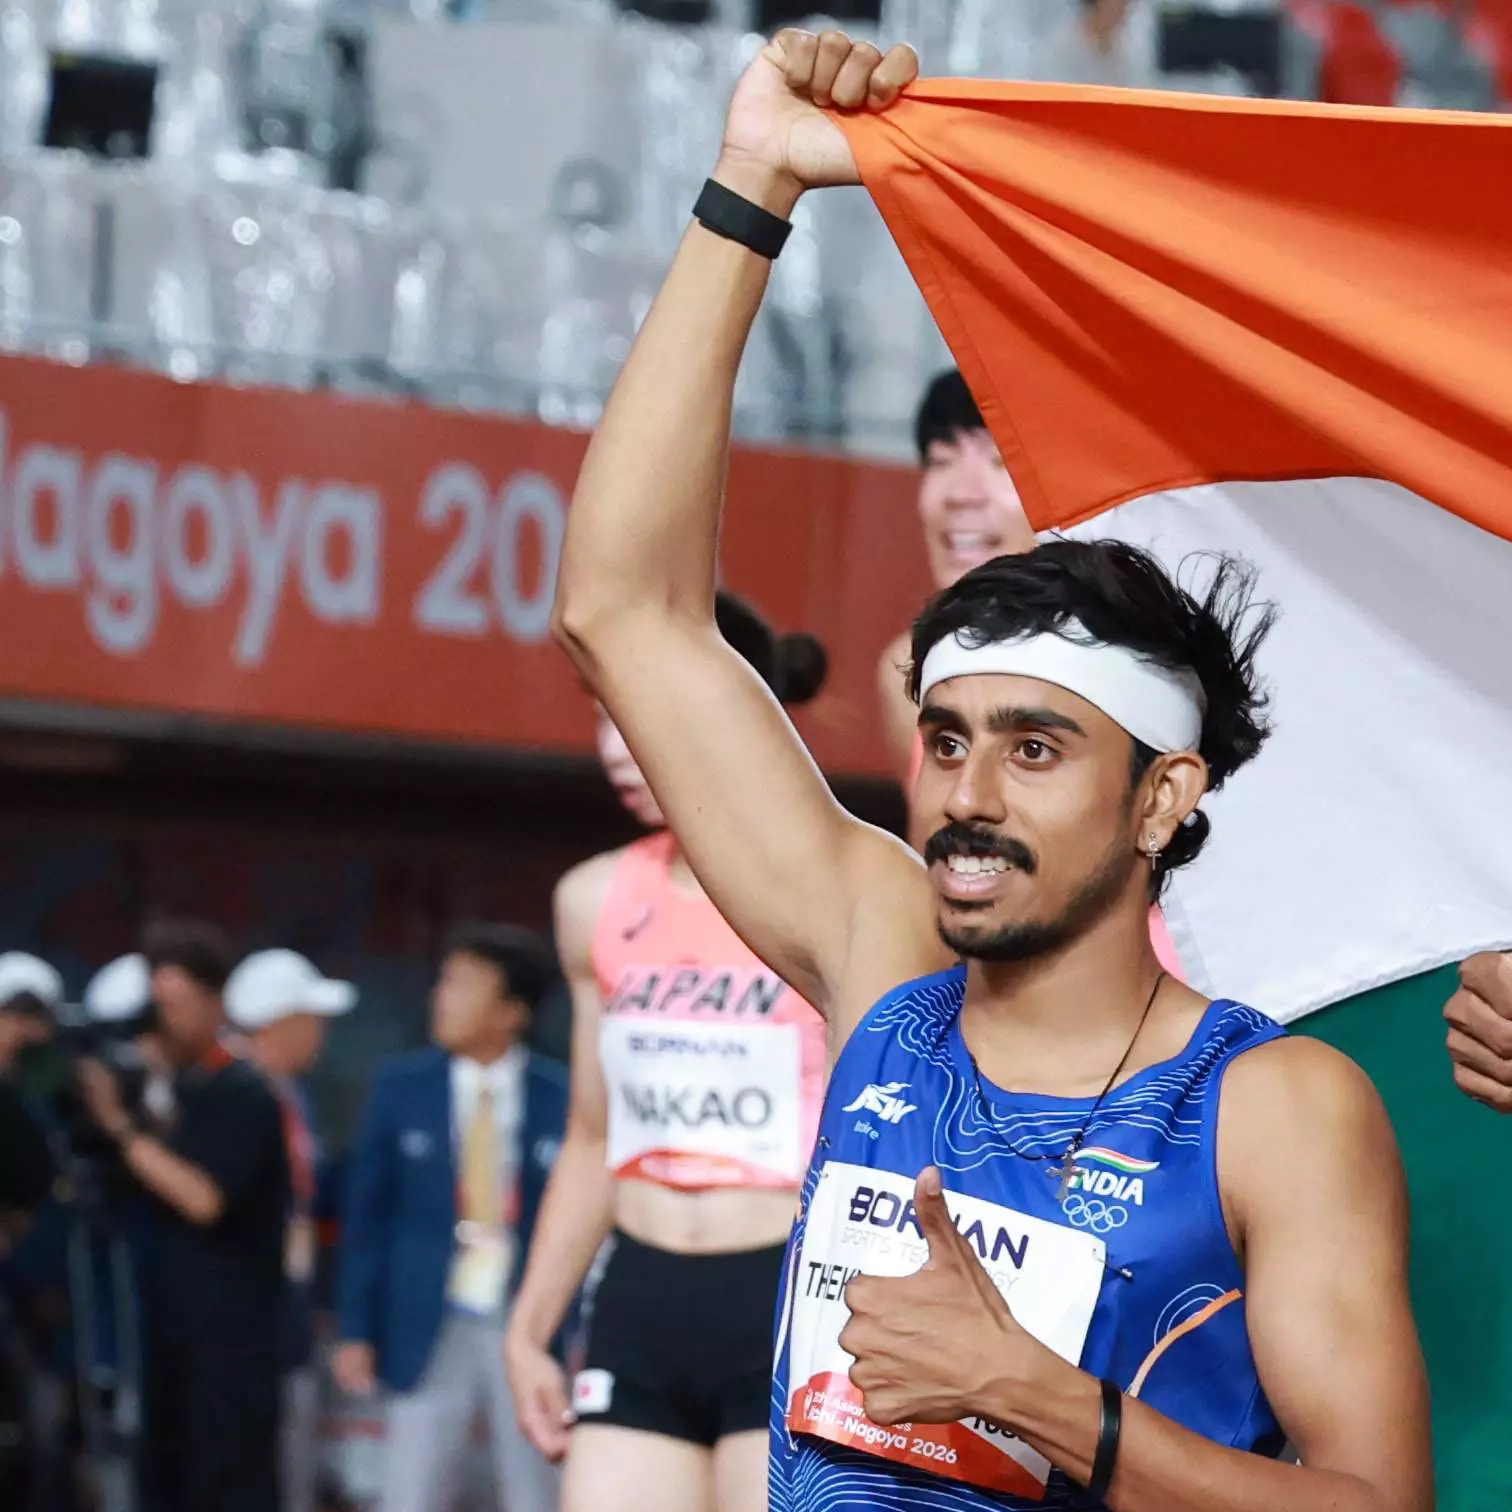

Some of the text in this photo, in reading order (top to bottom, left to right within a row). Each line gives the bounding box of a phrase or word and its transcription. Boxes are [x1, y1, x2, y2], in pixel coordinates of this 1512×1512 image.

[0, 410, 564, 667] agoya 20
[848, 1185, 1029, 1270] BORAN
[911, 1437, 959, 1465] 2026
